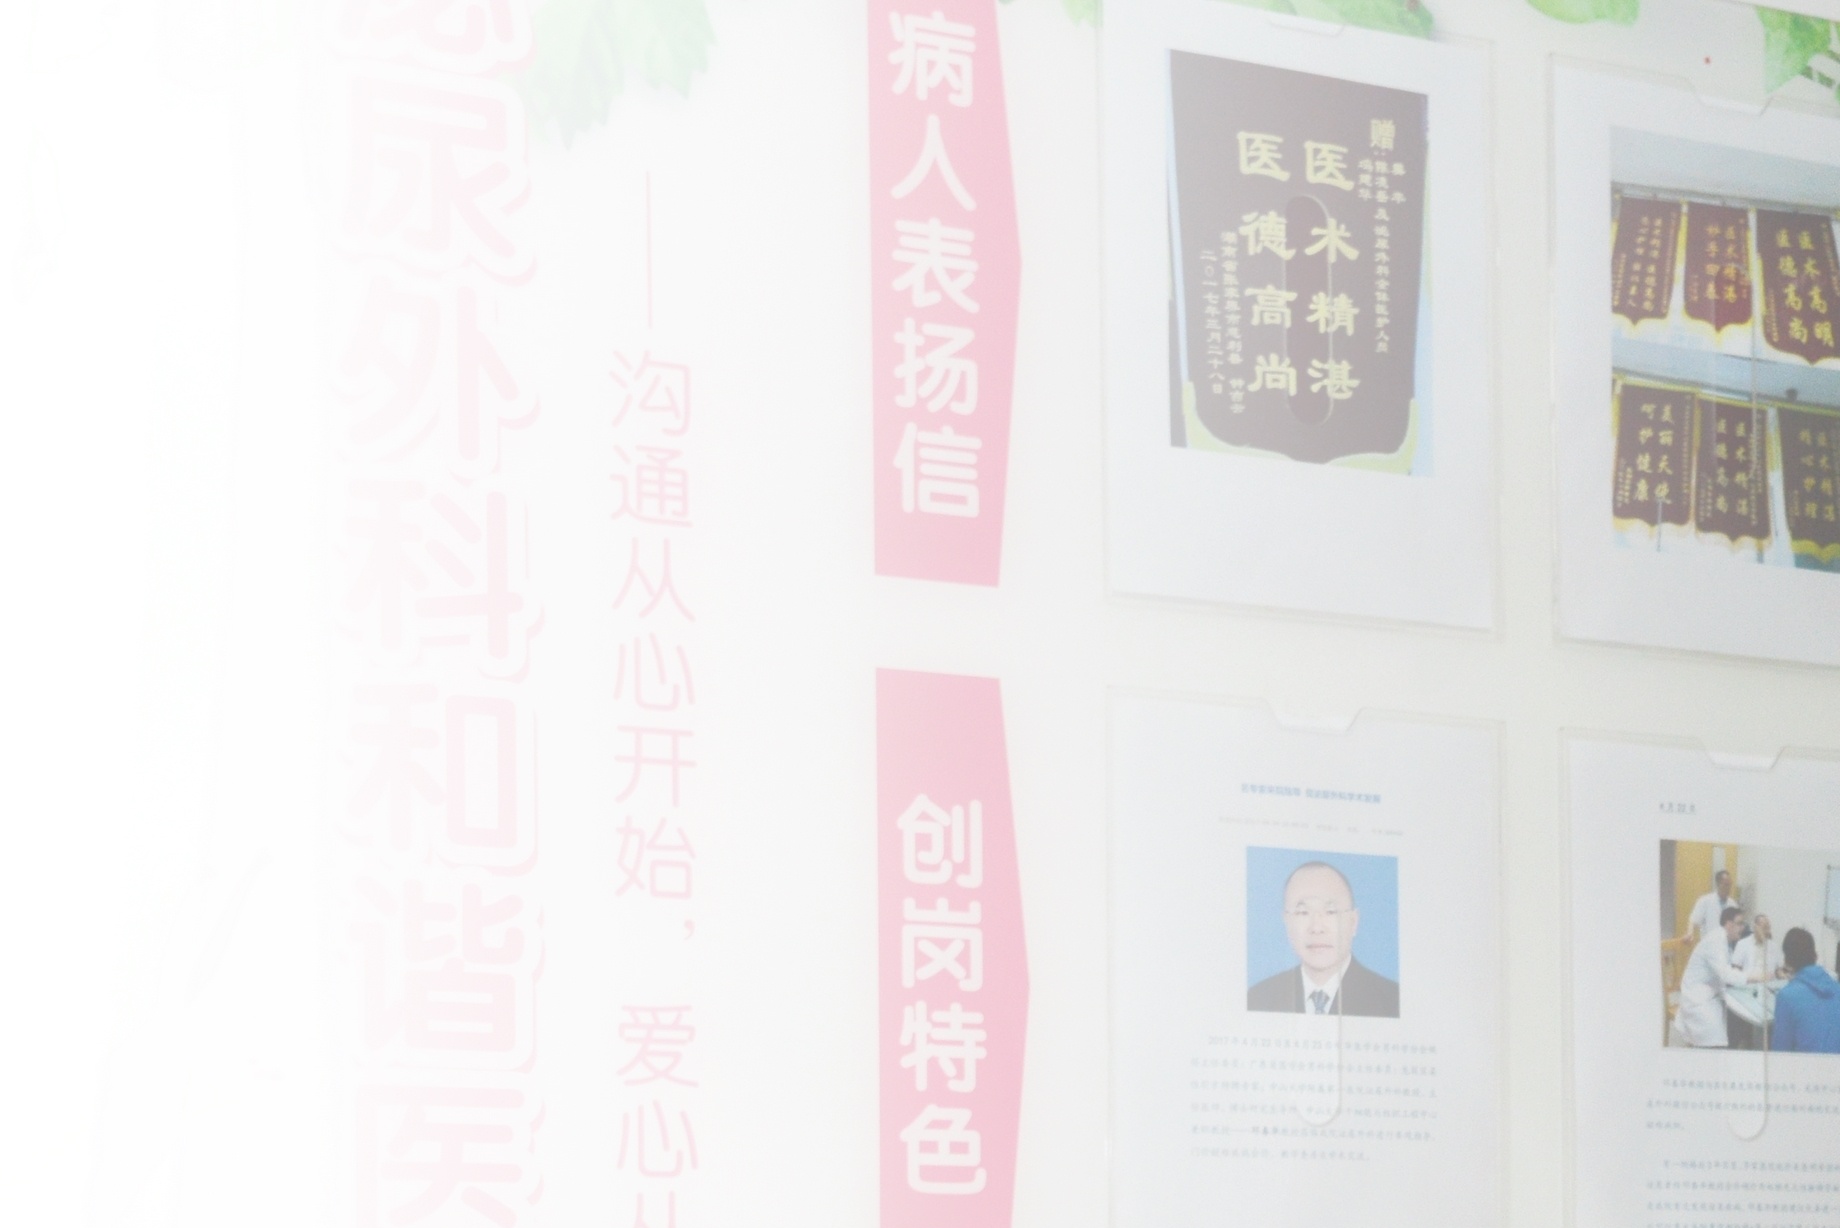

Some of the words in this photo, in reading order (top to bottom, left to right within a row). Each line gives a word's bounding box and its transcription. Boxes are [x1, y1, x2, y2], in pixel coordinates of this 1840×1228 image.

[888, 10, 984, 519] 病人表扬信
[1236, 130, 1298, 396] 医德高尚
[1303, 140, 1361, 400] 医术精湛
[897, 792, 988, 1196] 创岗特色
